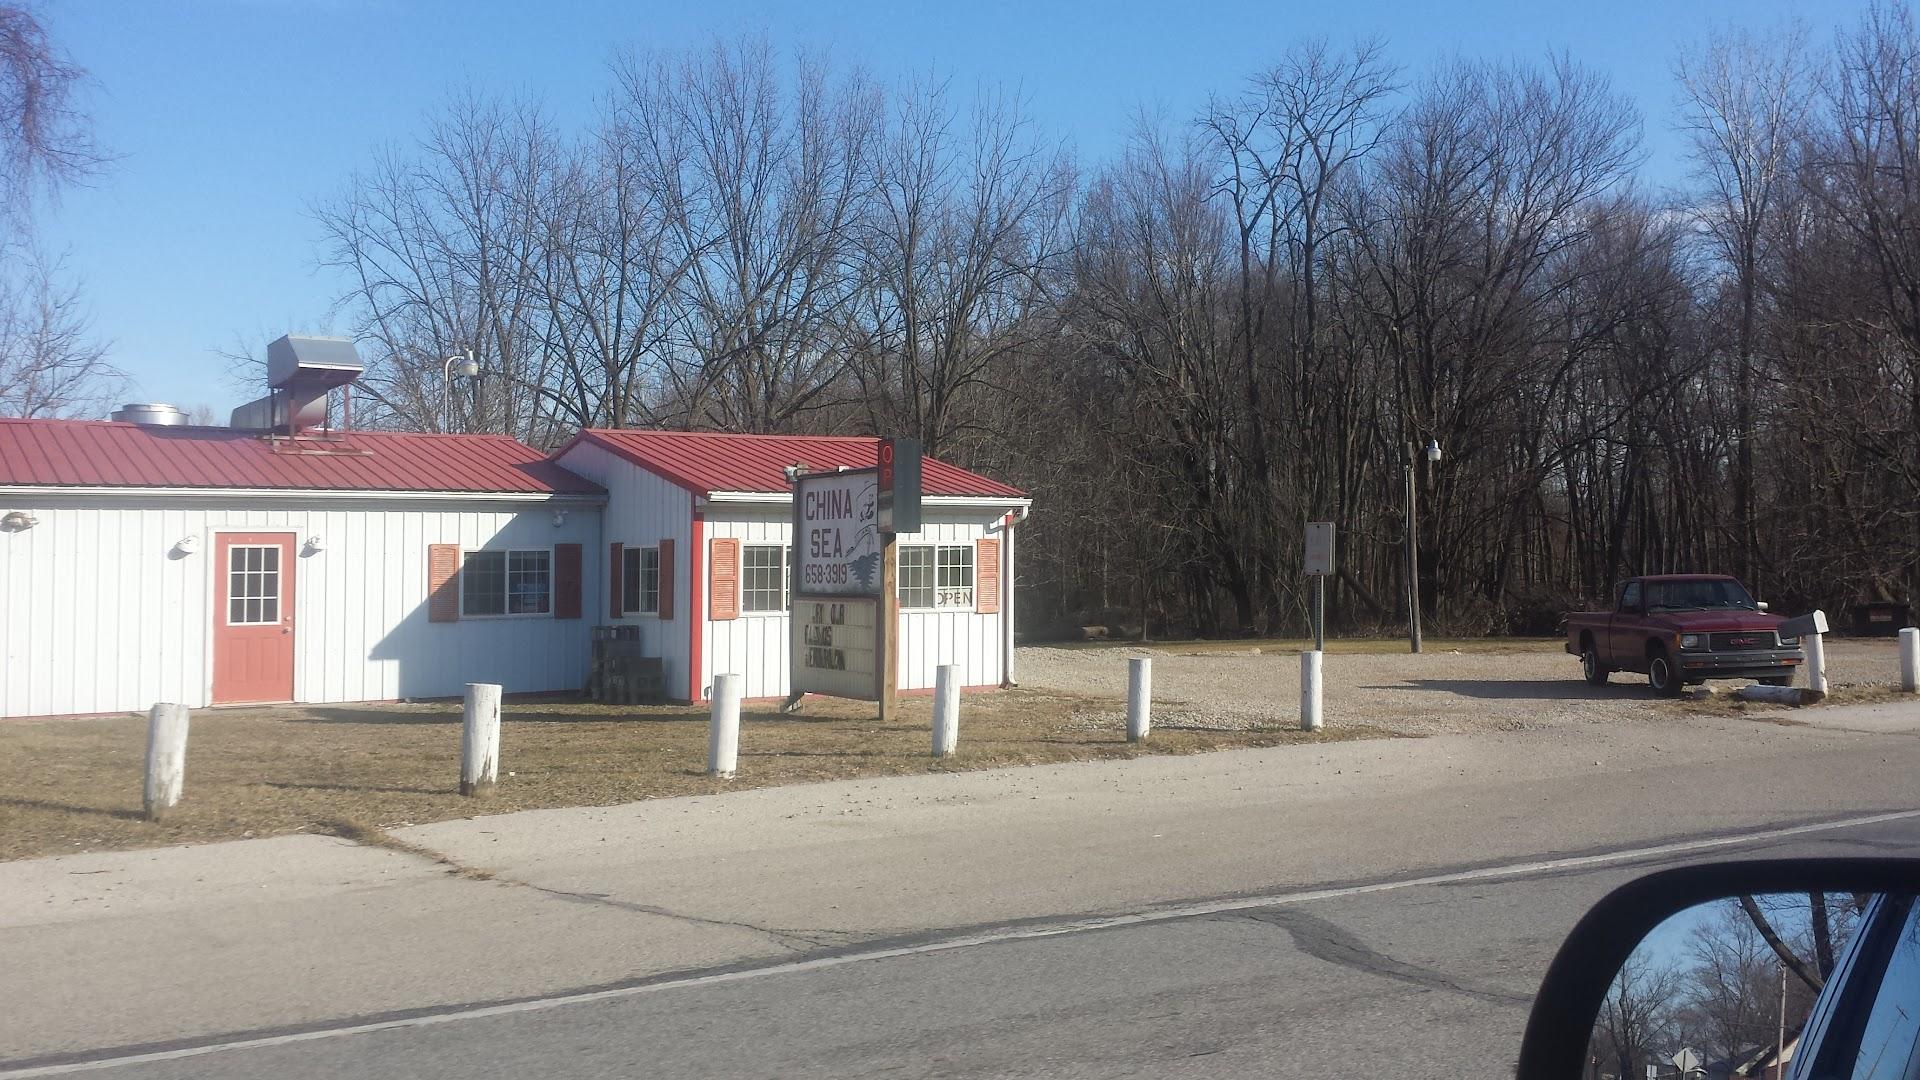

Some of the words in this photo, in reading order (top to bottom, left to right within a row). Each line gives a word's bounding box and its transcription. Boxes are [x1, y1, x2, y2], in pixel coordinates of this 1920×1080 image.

[806, 489, 853, 521] CHINA
[811, 528, 842, 558] SEA
[937, 591, 972, 605] OPEN
